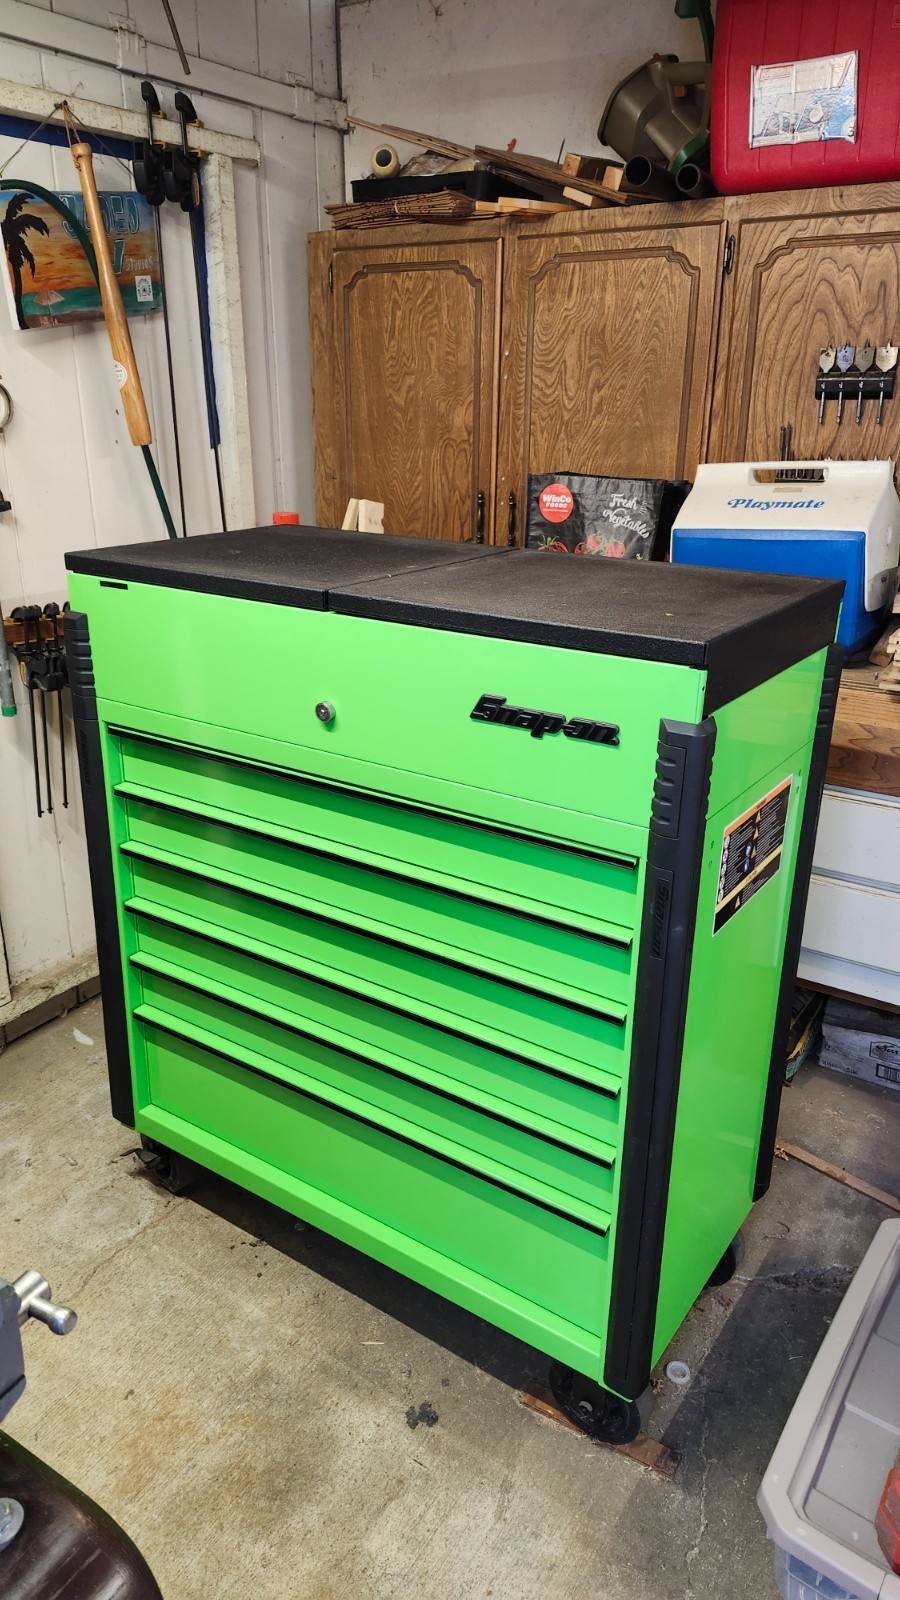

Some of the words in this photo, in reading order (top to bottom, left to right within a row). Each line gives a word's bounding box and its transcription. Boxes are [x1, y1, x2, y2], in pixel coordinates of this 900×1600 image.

[542, 494, 572, 504] WinCo
[609, 493, 638, 510] Fresh
[727, 498, 825, 511] Playmate
[603, 508, 650, 539] Vegetables
[470, 693, 620, 747] Snap-on
